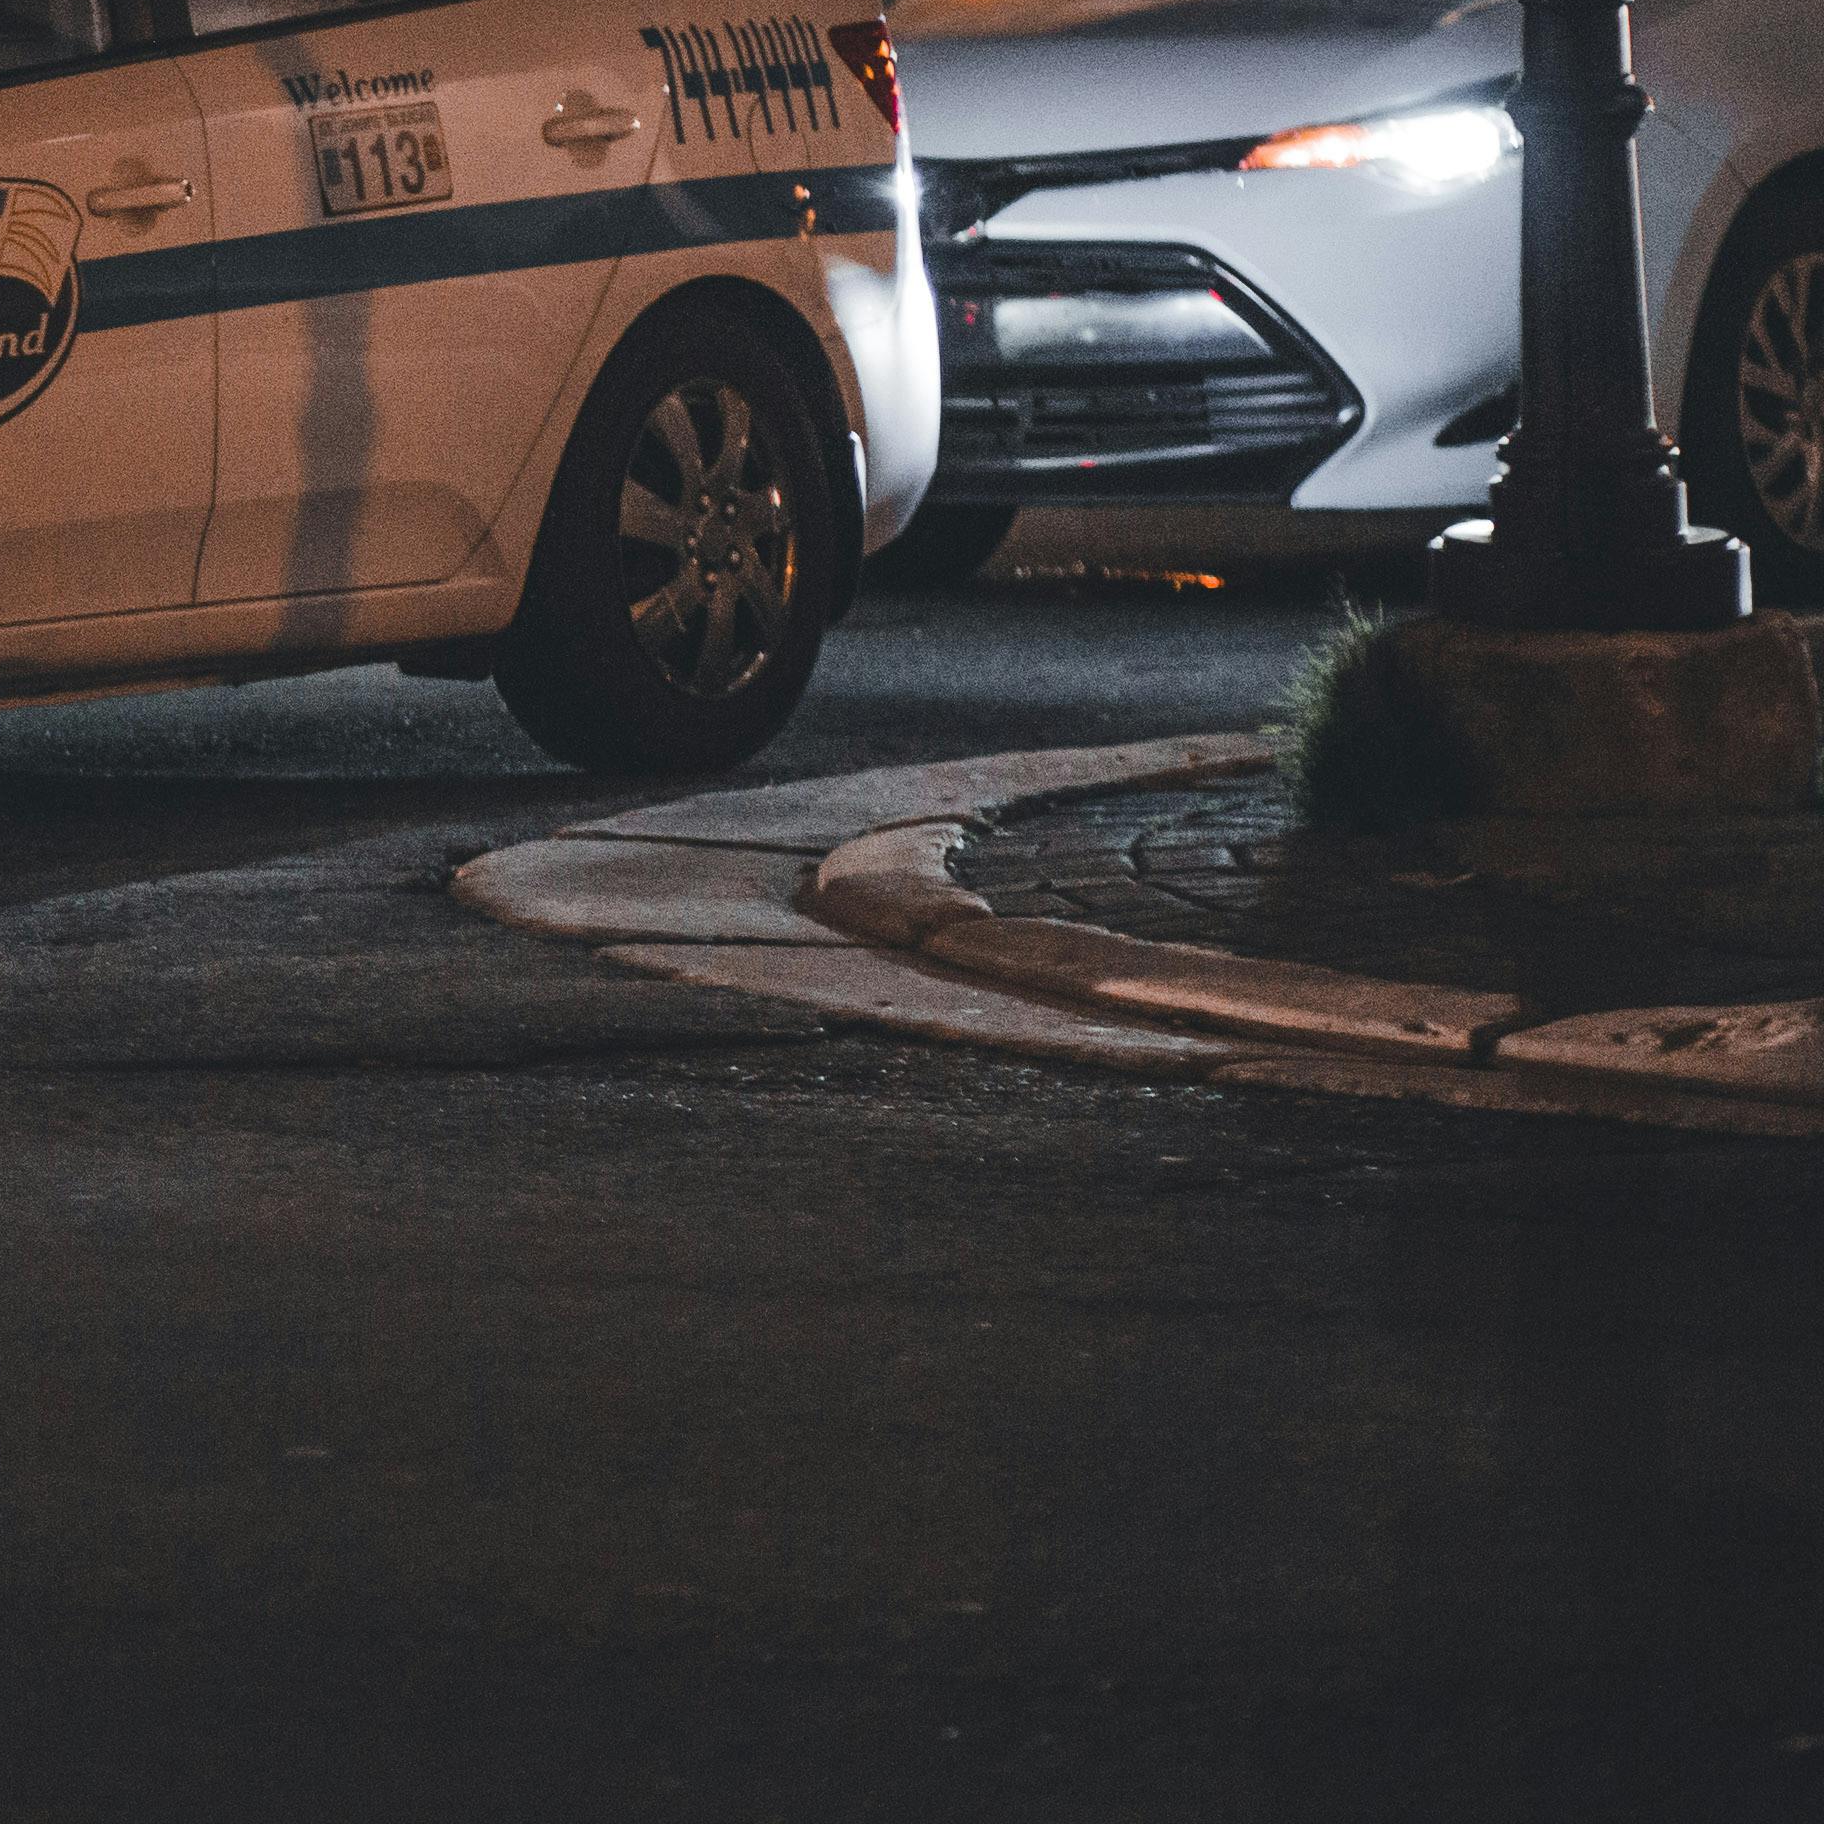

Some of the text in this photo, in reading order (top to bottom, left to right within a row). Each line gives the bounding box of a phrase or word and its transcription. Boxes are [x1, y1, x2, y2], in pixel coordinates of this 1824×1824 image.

[281, 68, 436, 112] Welcome
[638, 14, 841, 145] 744-4444
[341, 130, 427, 202] 113
